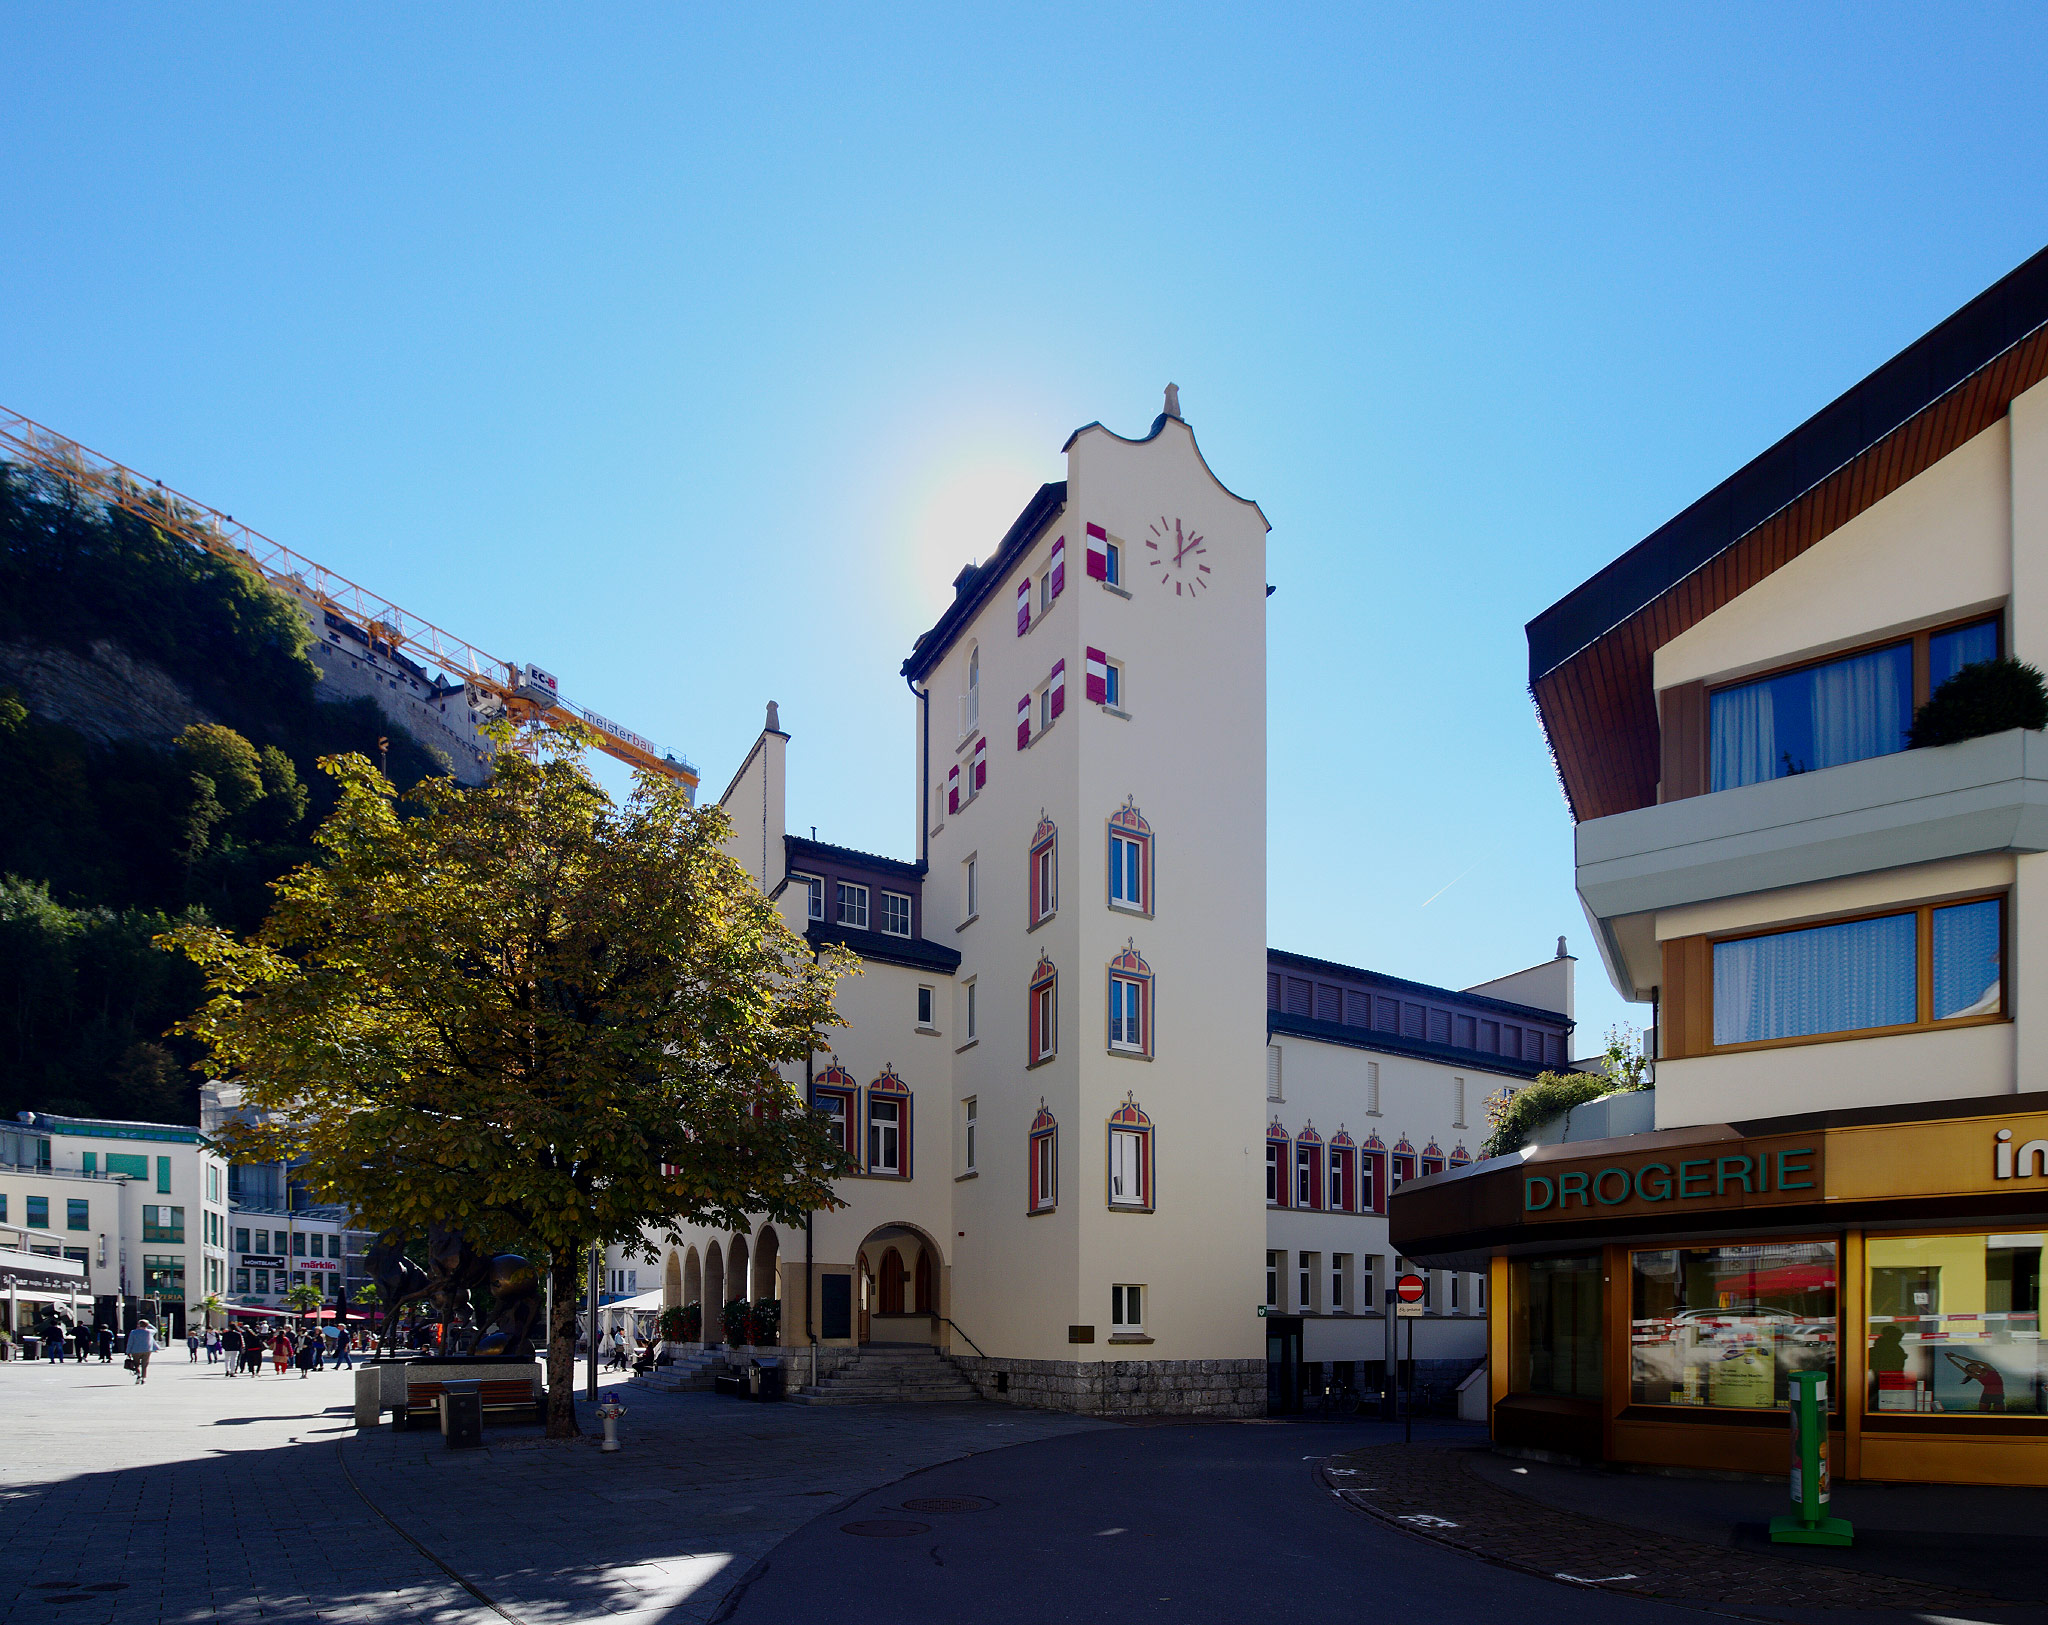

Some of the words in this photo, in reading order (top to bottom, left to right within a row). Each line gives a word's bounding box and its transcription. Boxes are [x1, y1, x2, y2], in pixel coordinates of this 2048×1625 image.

[532, 668, 556, 689] EC-B
[583, 711, 655, 755] meisterbau
[1525, 1148, 1814, 1211] DROGERIE
[244, 1259, 279, 1267] MONTBLANC
[301, 1260, 336, 1270] märklin
